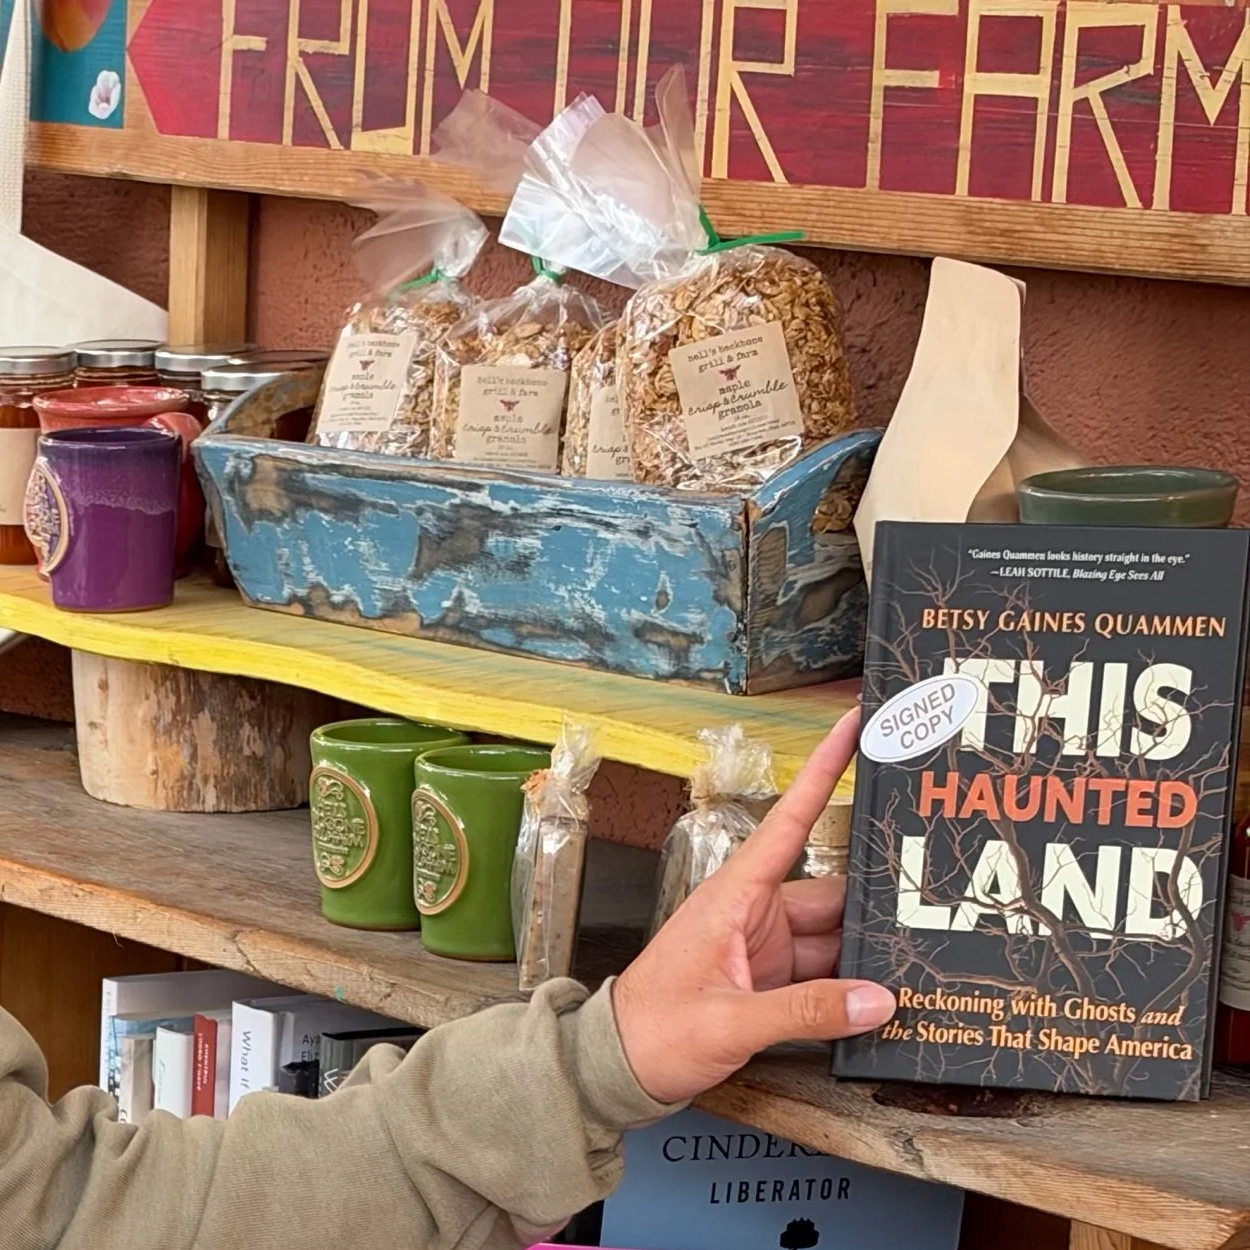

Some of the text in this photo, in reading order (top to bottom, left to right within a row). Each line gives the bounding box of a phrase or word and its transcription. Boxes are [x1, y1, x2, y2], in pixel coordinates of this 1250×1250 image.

[866, 0, 1250, 216] FARM
[698, 359, 726, 373] grill
[736, 348, 759, 361] farm
[719, 336, 763, 355] backbone
[718, 380, 751, 395] maple
[718, 399, 763, 420] granola
[1003, 549, 1045, 562] Quammen
[1047, 550, 1070, 561] looks
[1072, 551, 1103, 565] history
[1105, 552, 1139, 566] straight
[1141, 552, 1149, 563] in
[1151, 552, 1166, 563] the
[1072, 568, 1107, 582] Blazing
[1108, 570, 1126, 582] Eye
[1127, 570, 1149, 581] Sees
[1149, 570, 1165, 581] All
[922, 608, 1227, 639] BETSY GAINES QUAMMEN
[880, 682, 956, 738] SIGNED
[900, 705, 955, 750] COPY
[943, 657, 1193, 761] THIS
[918, 770, 1198, 829] HAUNTED
[895, 835, 1204, 943] LAND
[899, 987, 1186, 1027] Reckoning with Ghosts and
[240, 1030, 252, 1072] What
[881, 1020, 1193, 1061] the Stories That Shape America
[709, 1177, 851, 1205] LIBERATOR
